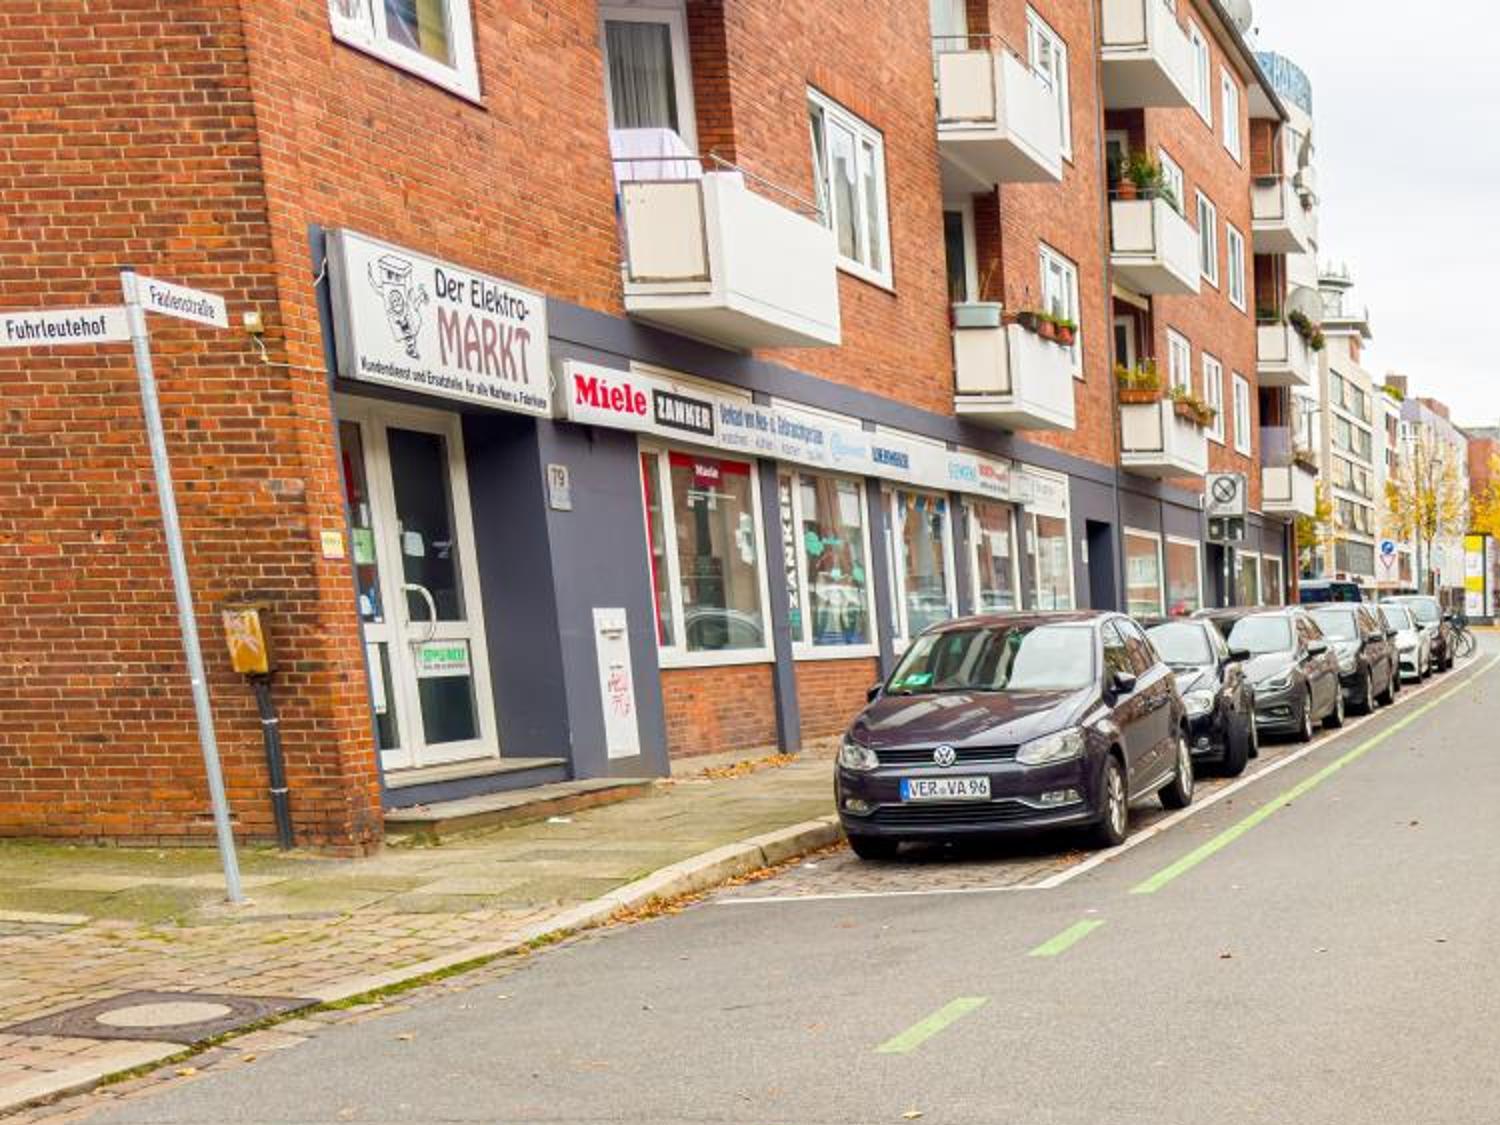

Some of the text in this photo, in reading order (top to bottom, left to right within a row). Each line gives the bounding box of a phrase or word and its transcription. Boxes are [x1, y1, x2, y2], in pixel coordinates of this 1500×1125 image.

[435, 268, 529, 320] Der Elektro-
[6, 315, 107, 339] Fuhrleutehof
[438, 306, 530, 384] MARKT
[574, 373, 647, 416] Miele
[657, 396, 711, 429] ZANKER
[910, 780, 987, 797] VER VA 96
